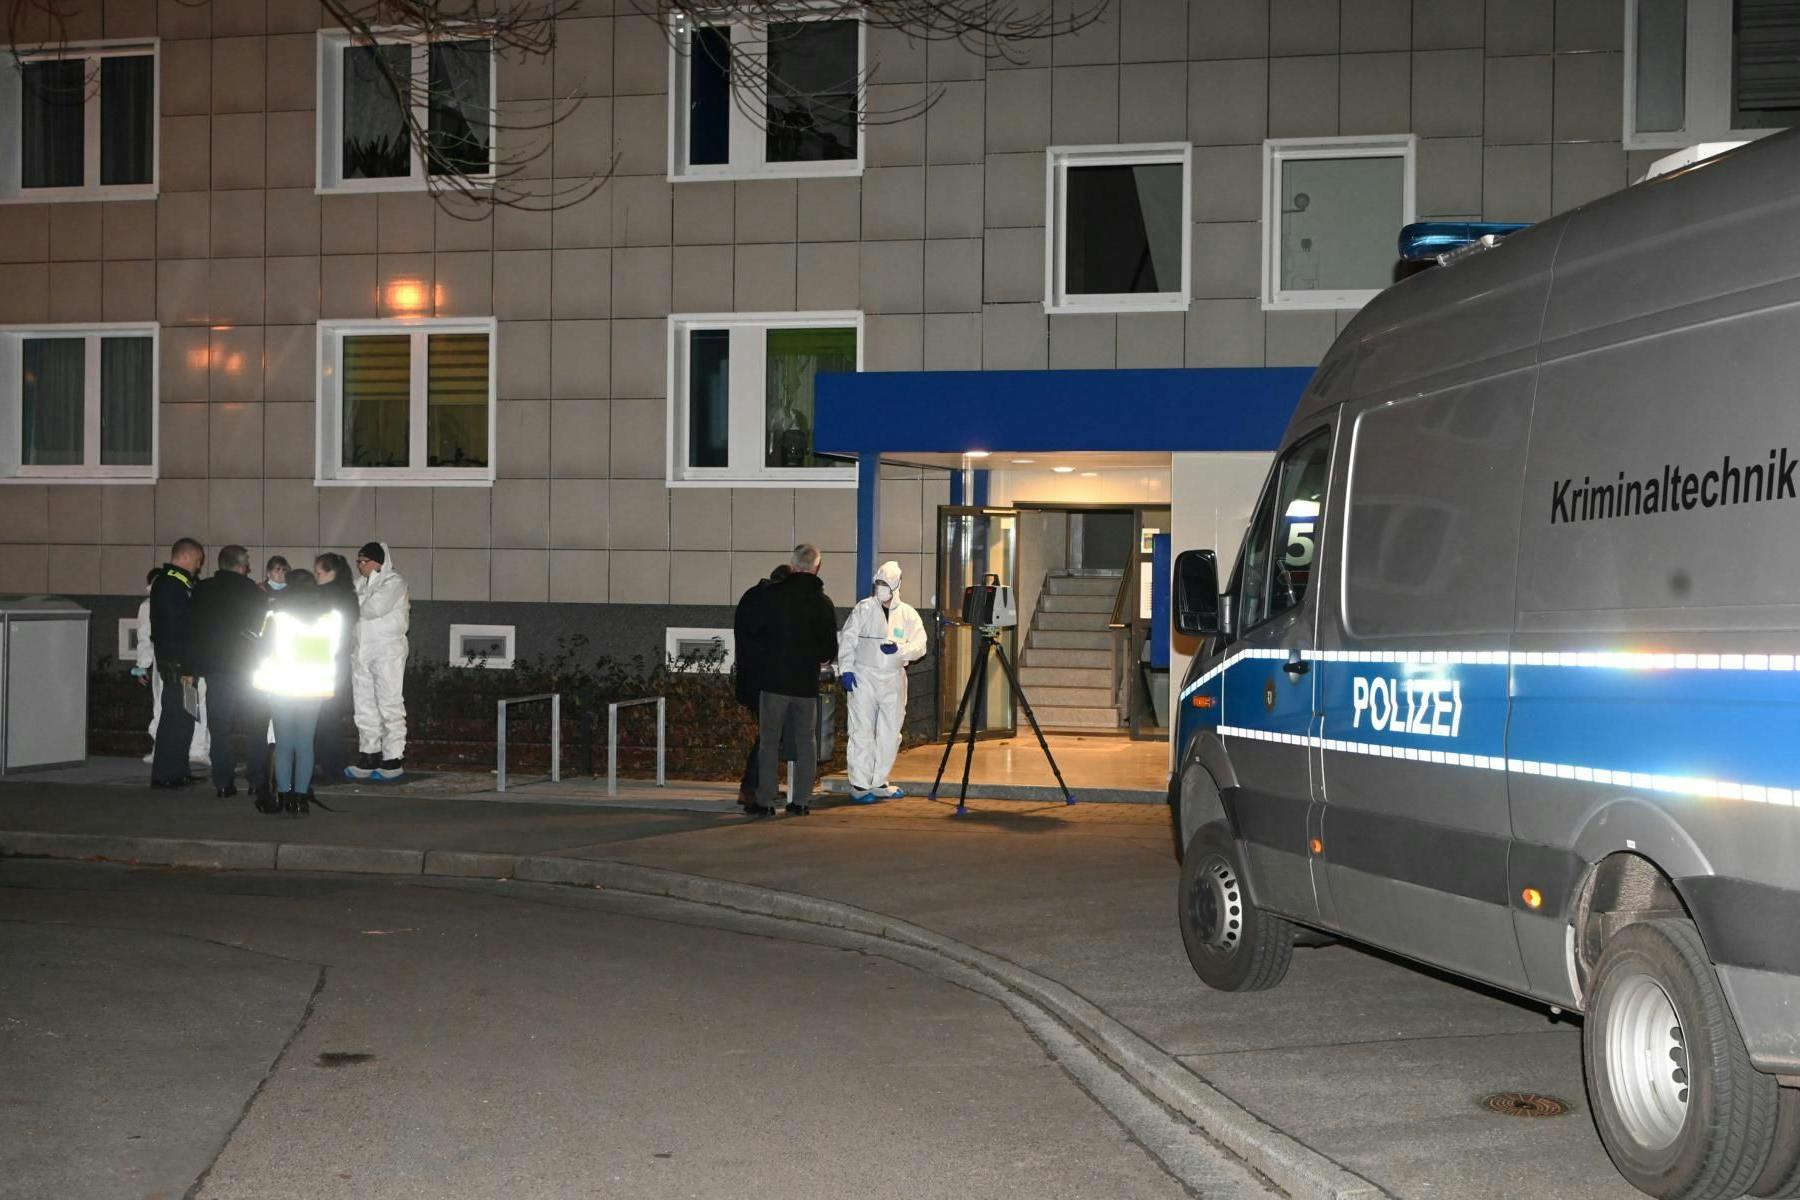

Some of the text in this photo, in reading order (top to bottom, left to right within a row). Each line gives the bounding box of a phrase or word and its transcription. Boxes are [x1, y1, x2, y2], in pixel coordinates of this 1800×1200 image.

[1551, 448, 1799, 524] Kriminaltechnik
[1285, 522, 1314, 566] 5
[1353, 676, 1462, 737] POLIZEI
